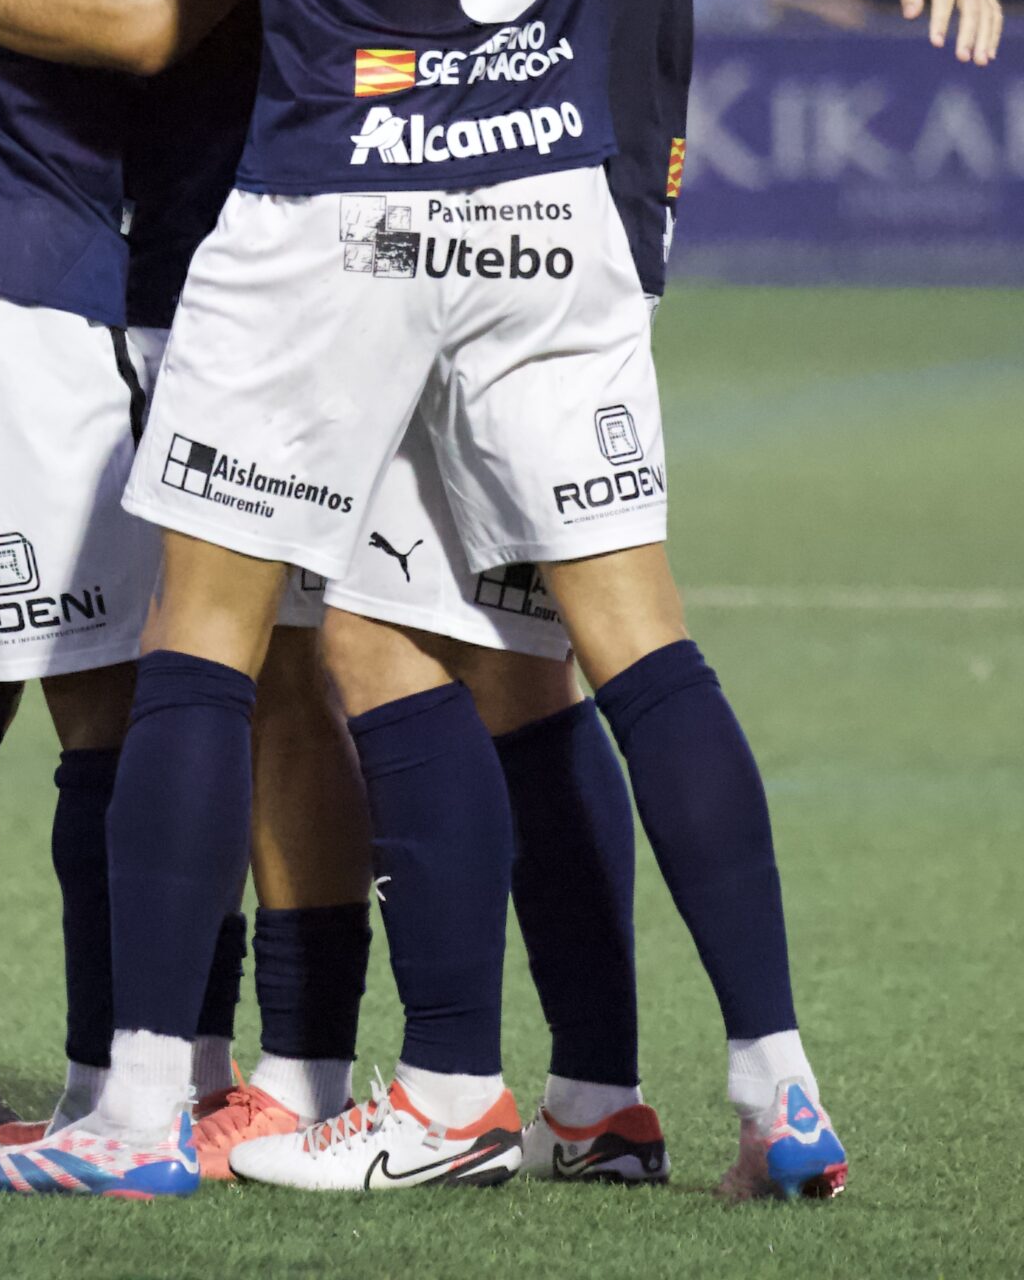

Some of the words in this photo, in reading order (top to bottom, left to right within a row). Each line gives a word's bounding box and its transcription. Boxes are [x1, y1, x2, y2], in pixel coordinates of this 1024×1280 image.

[350, 101, 584, 165] Alcampo
[428, 198, 573, 222] Pavimentos
[425, 234, 574, 279] Utebo
[206, 483, 275, 518] Laurentiu
[212, 454, 355, 513] Aislamientos
